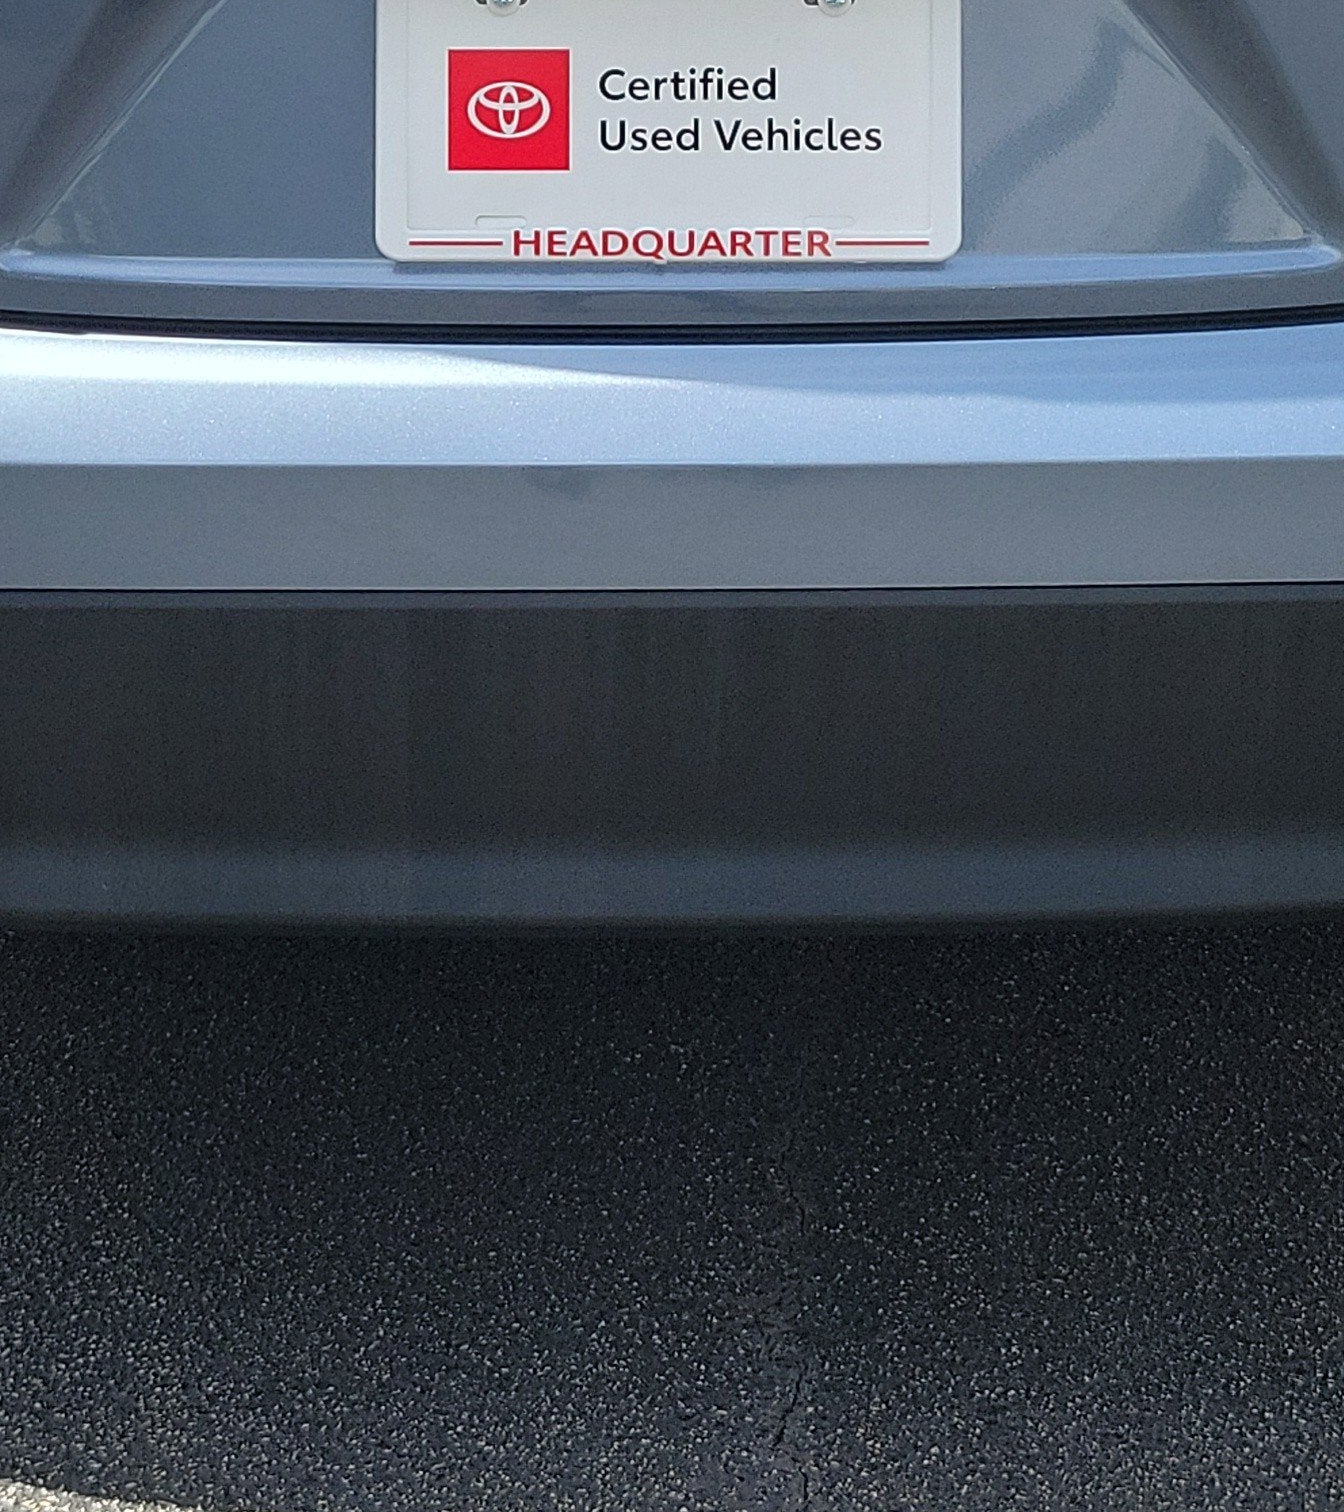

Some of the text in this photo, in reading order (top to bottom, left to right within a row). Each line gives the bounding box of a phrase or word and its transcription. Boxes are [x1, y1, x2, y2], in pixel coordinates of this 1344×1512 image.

[599, 67, 777, 101] Certified
[600, 117, 883, 151] Used Vehicles
[512, 229, 832, 260] HEADQUARTER
